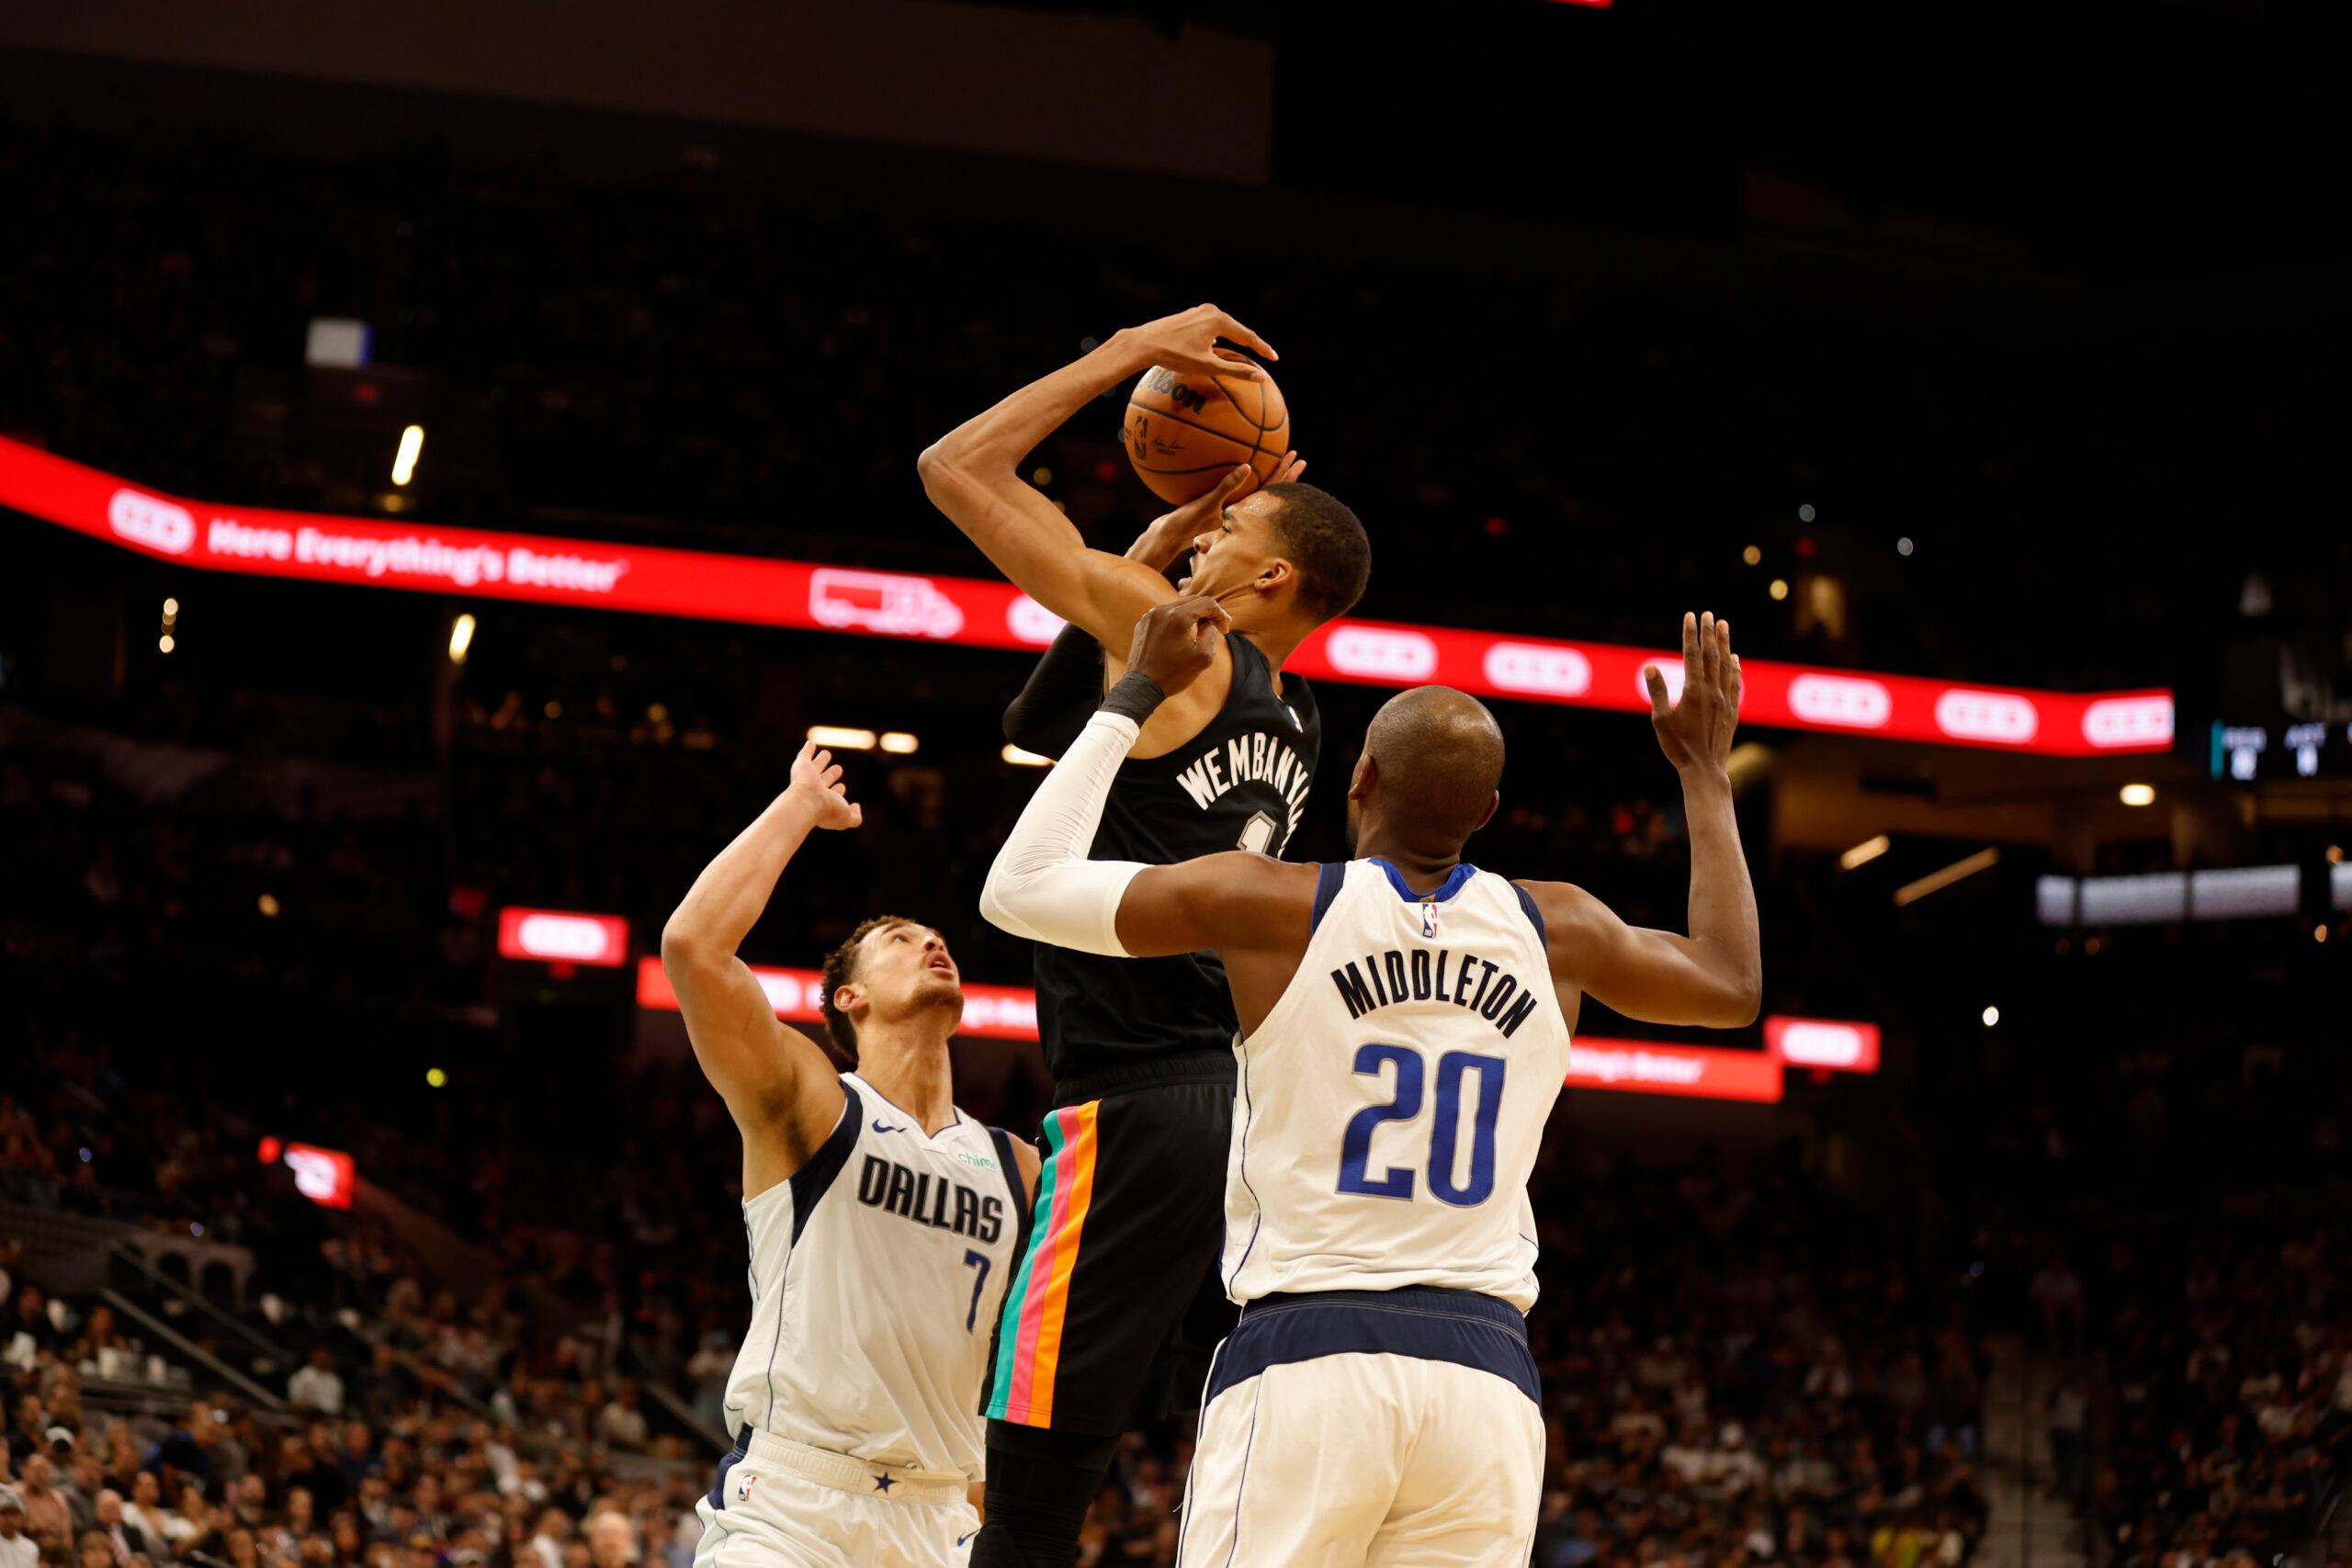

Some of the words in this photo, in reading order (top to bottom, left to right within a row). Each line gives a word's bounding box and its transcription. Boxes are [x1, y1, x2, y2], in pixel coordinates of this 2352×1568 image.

[1148, 369, 1205, 415] lson
[1330, 948, 1538, 1040] MIDDLETON
[1333, 1042, 1508, 1209] 20
[857, 1152, 1004, 1247] DALLAS
[963, 1247, 991, 1336] 7
